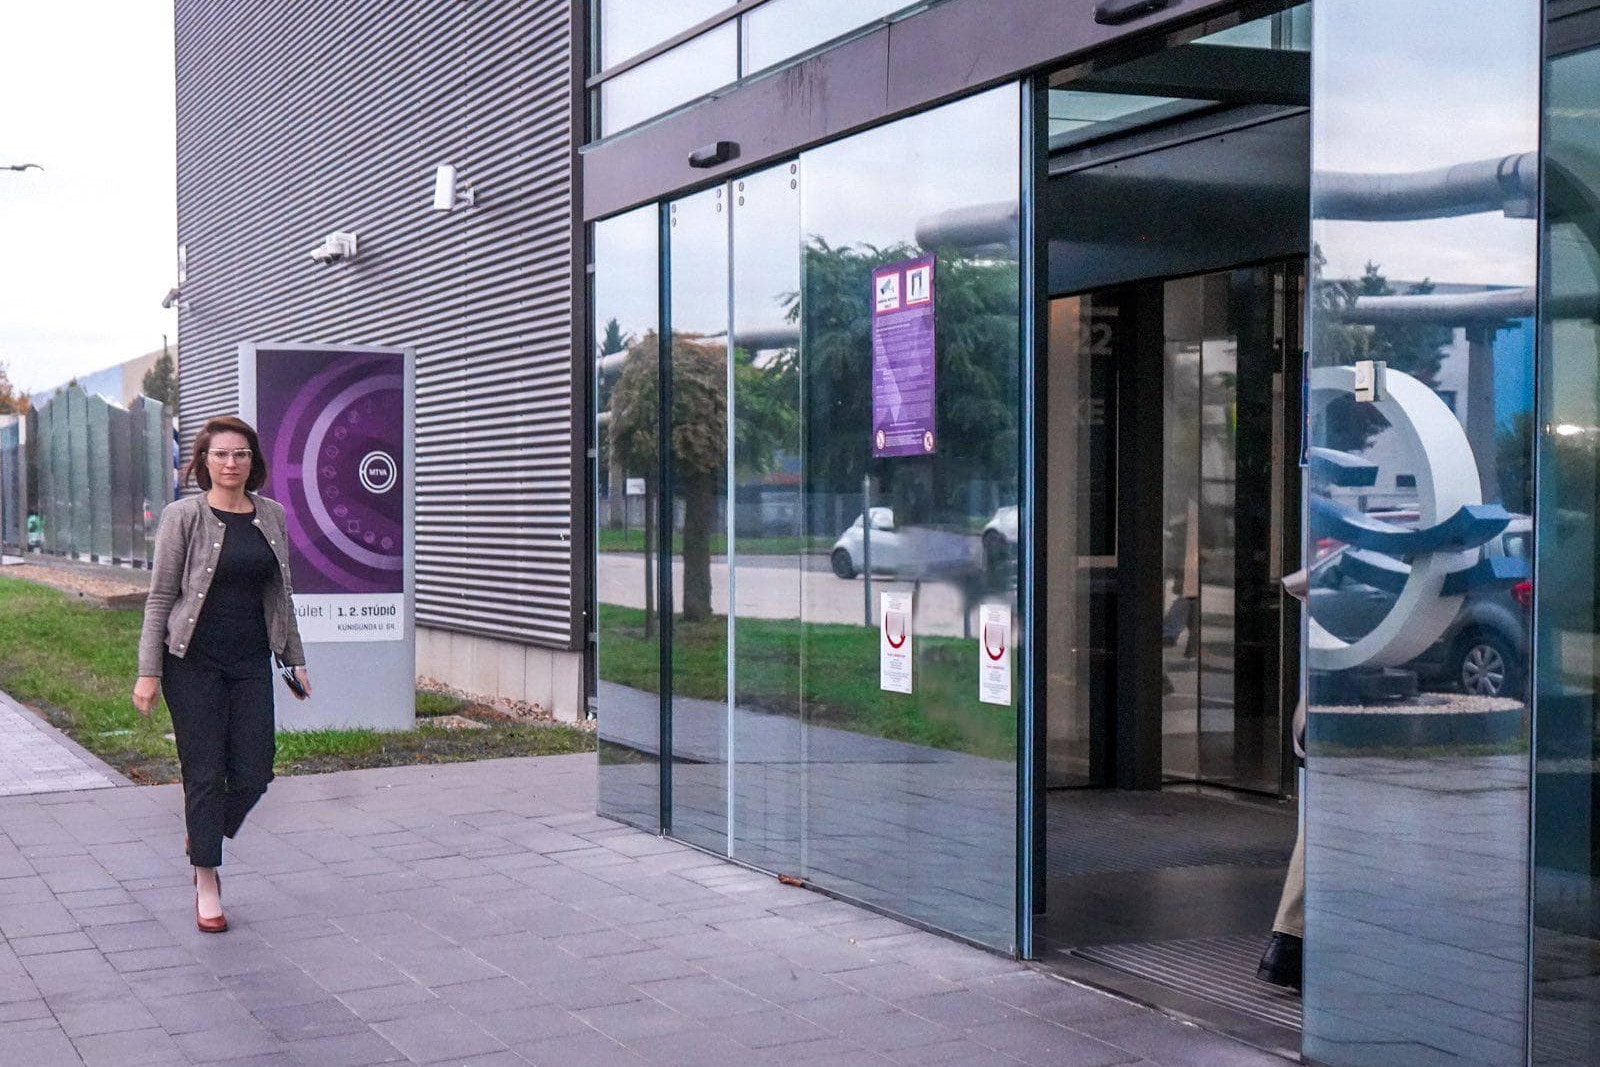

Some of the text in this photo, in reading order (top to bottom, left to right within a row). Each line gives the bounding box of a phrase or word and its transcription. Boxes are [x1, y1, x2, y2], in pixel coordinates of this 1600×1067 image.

[368, 468, 388, 476] MTVA
[337, 603, 397, 617] 1. 2. STÚDIÓ
